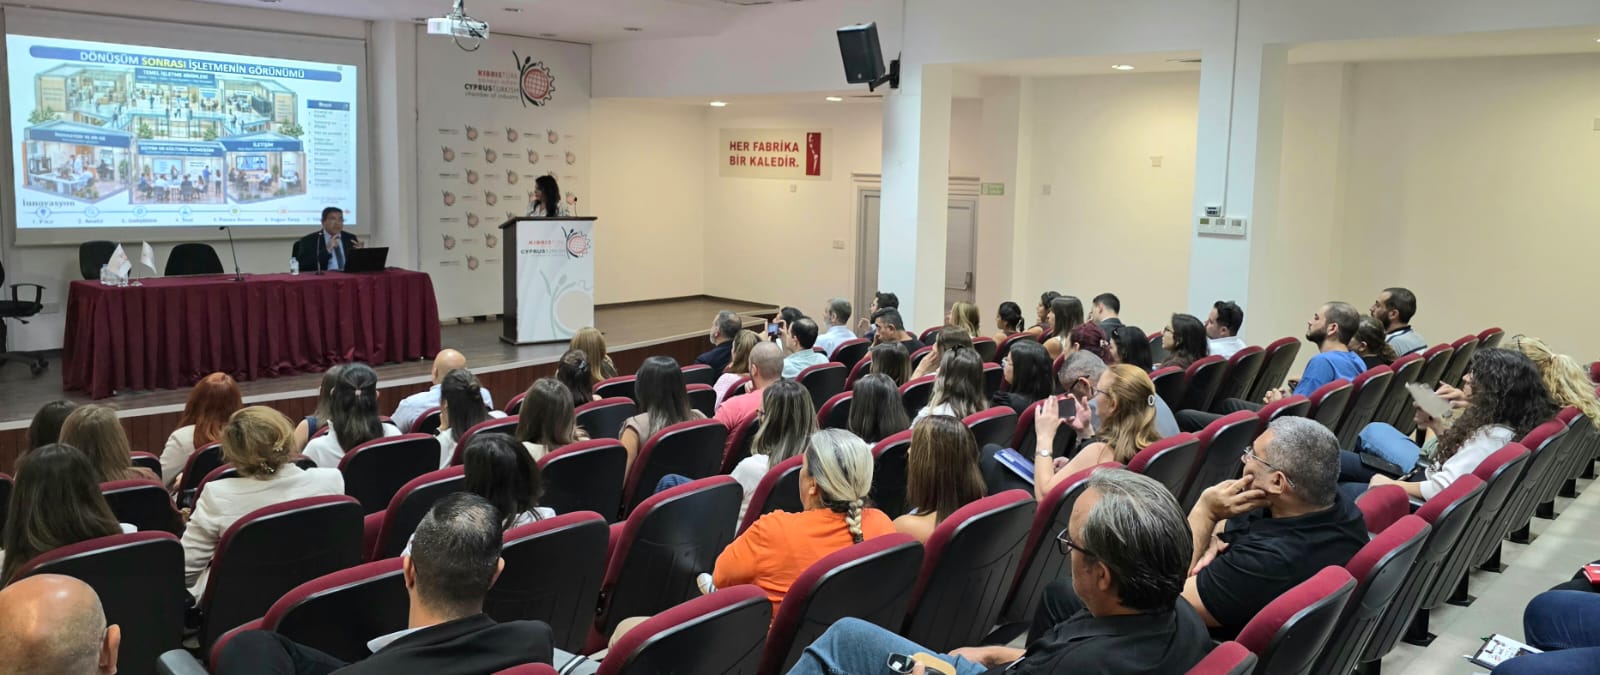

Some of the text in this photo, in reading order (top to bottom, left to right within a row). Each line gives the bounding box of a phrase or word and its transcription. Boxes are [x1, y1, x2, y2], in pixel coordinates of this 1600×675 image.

[80, 51, 305, 78] DÖNÜŞÜM SONRASI İŞLETMENİN GÖRÜNÜMÜ
[729, 140, 799, 152] HER FABRİKA
[729, 154, 799, 167] BİR KALEDİR.
